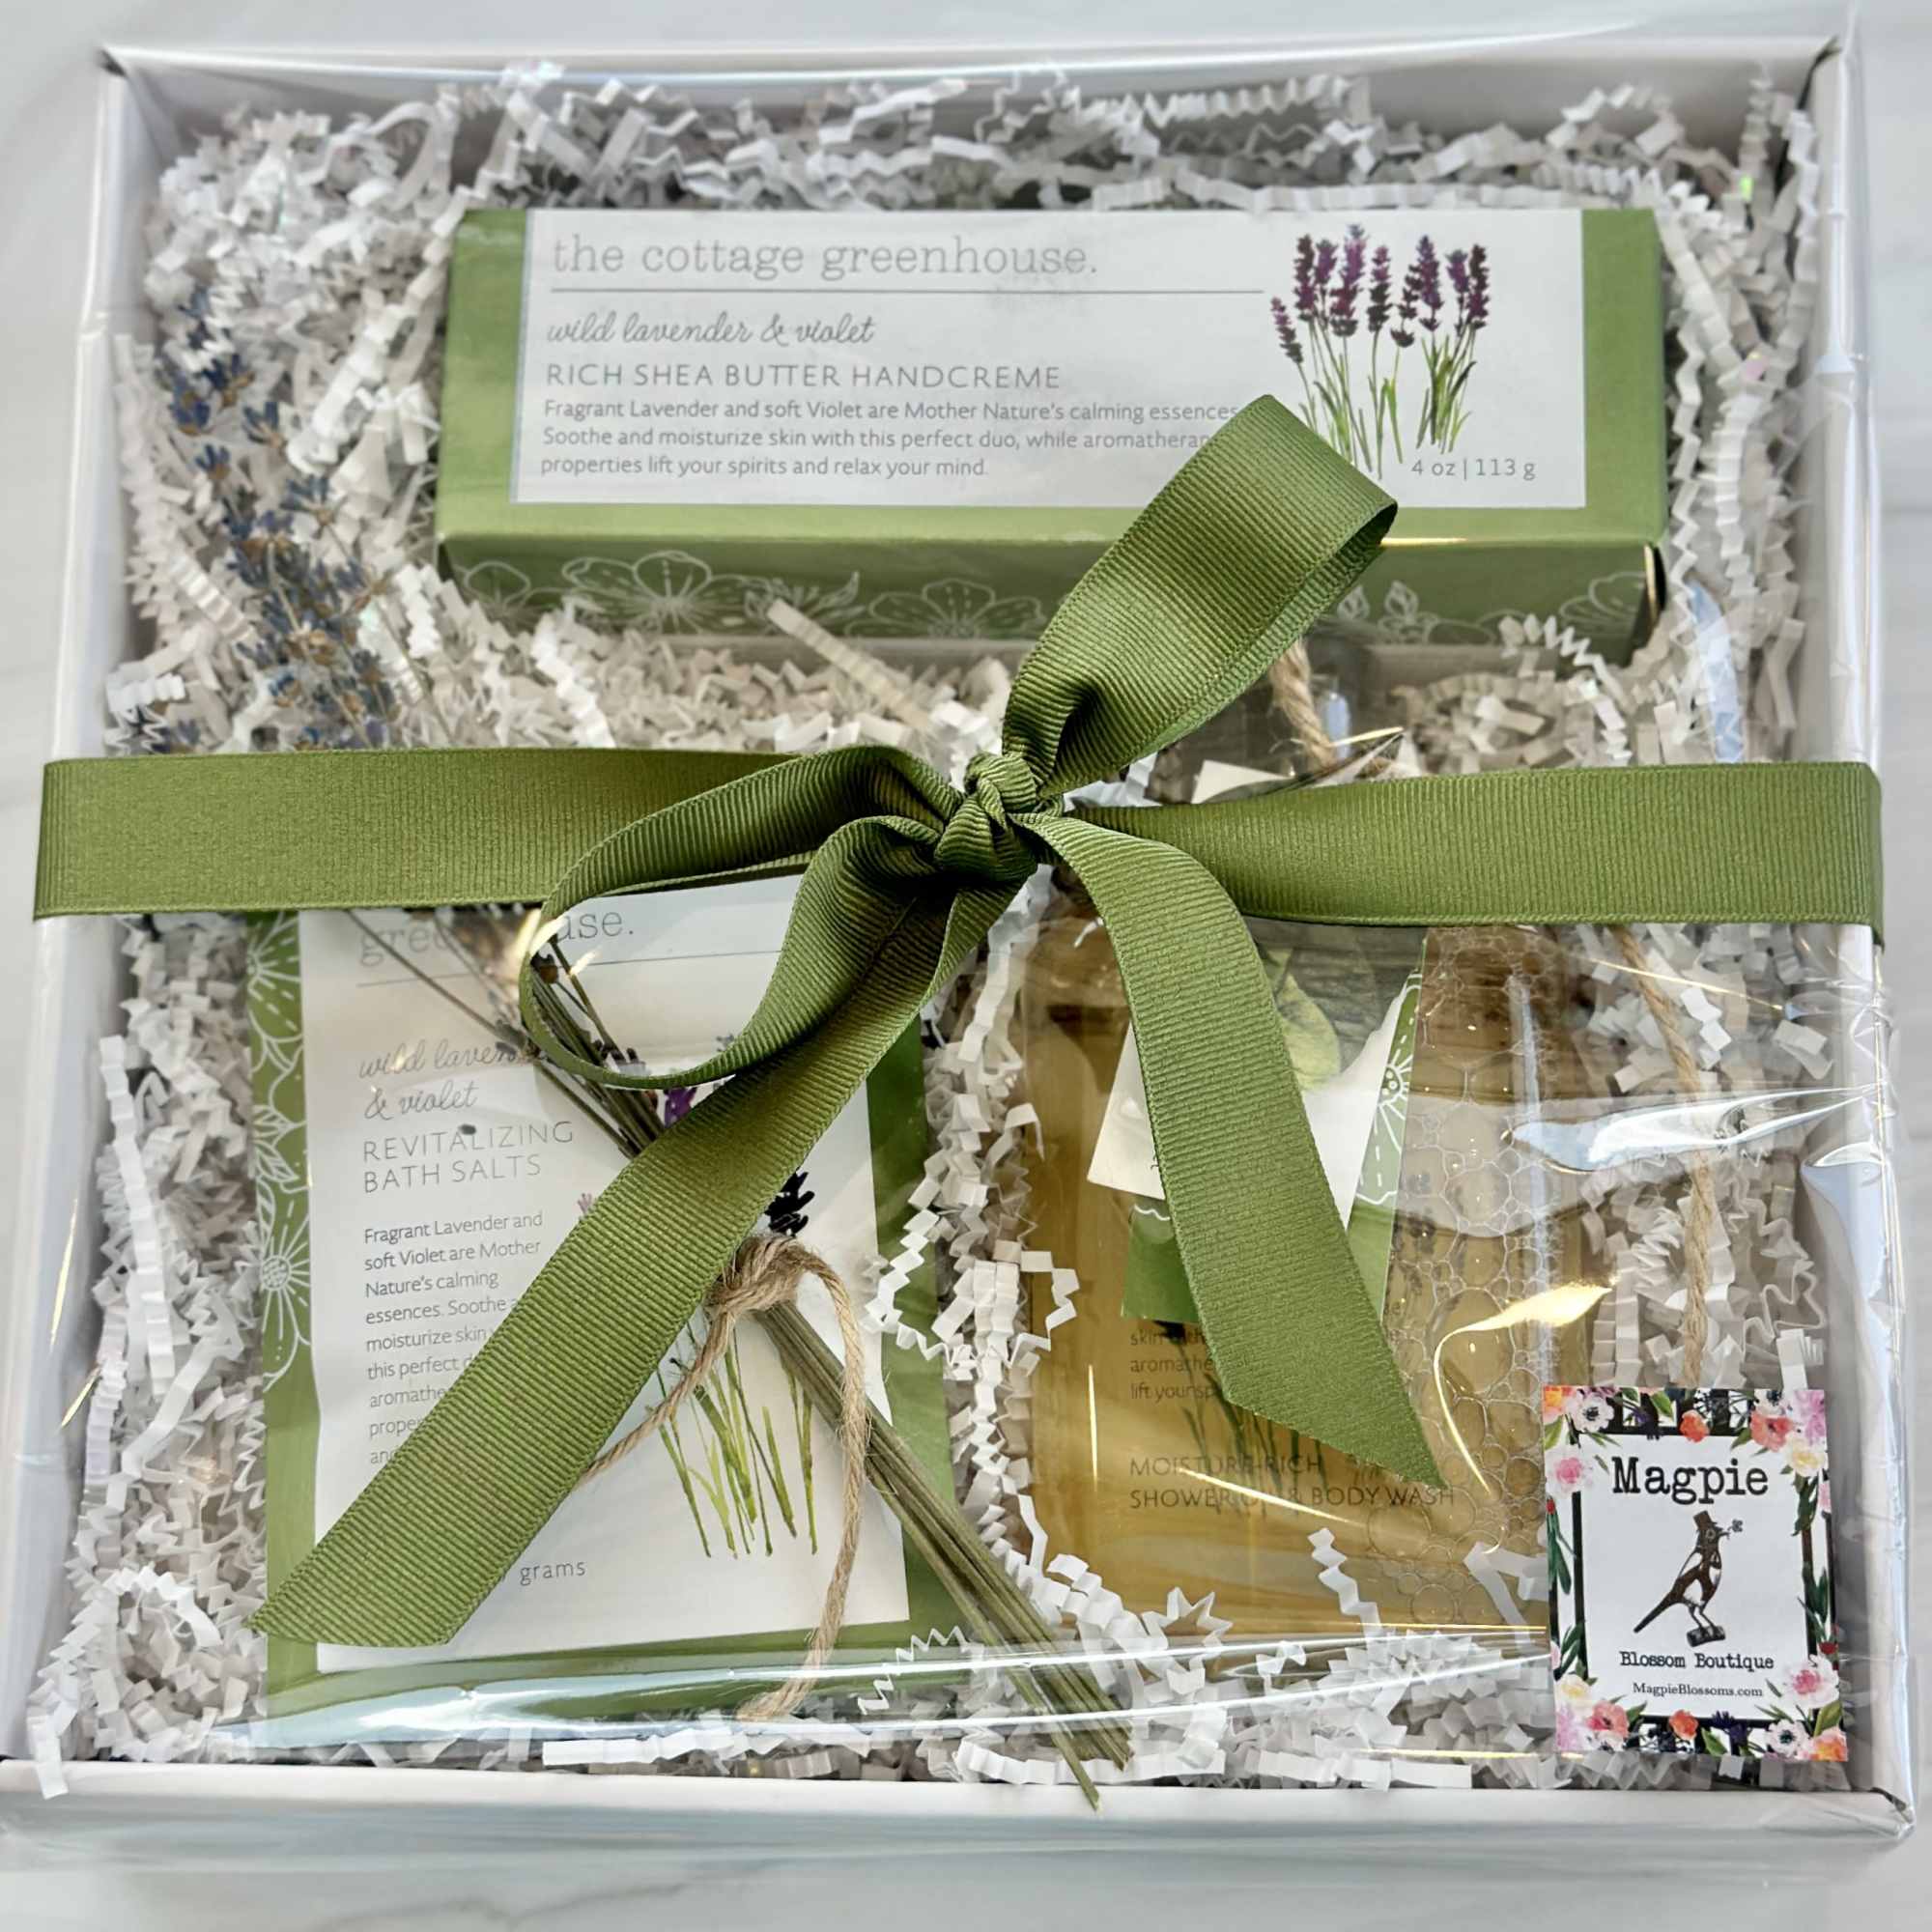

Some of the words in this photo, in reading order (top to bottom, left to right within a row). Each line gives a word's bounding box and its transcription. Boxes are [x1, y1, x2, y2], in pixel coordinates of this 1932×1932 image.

[554, 233, 624, 272] the
[642, 240, 804, 281] cottage
[820, 235, 1097, 282] greenhouse.
[547, 310, 616, 343] wild
[623, 310, 753, 343] lavender
[760, 312, 790, 347] &
[795, 312, 875, 344] violet
[547, 363, 623, 387] RICH
[634, 363, 713, 387] SHEA
[725, 364, 840, 387] BUTTER
[853, 365, 1060, 388] HANDCREME
[545, 399, 623, 421] Fragrant
[630, 399, 719, 418] Lavender
[724, 400, 759, 418] and
[764, 399, 801, 418] soft
[807, 401, 865, 419] Violet
[867, 405, 899, 419] are
[904, 401, 977, 420] Mother
[983, 402, 1064, 421] Nature's
[1069, 402, 1145, 424] calming
[543, 425, 612, 446] Soothe
[617, 427, 653, 445] and
[659, 427, 763, 447] moisturize
[769, 428, 807, 447] skin
[810, 429, 855, 447] with
[860, 428, 895, 447] this
[901, 428, 975, 451] perfect
[979, 430, 1021, 451] duo,
[1026, 430, 1077, 448] while
[541, 457, 642, 477] properties
[648, 456, 673, 473] lift
[678, 460, 722, 479] your
[728, 456, 788, 478] spirits
[793, 456, 828, 474] and
[834, 457, 881, 474] relax
[886, 462, 931, 480] your
[935, 458, 988, 475] mind.
[1411, 459, 1423, 476] 4
[1523, 462, 1538, 481] g
[358, 1039, 427, 1078] wild
[434, 1038, 519, 1069] laven
[364, 1087, 394, 1121] &
[398, 1080, 479, 1114] violet
[363, 1121, 574, 1162] REVITALIZING
[364, 1163, 440, 1193] BATH
[451, 1153, 541, 1182] SALTS
[364, 1222, 432, 1245] Fragrant
[434, 1214, 509, 1237] Lavender
[513, 1211, 543, 1230] and
[364, 1253, 396, 1271] soft
[399, 1246, 446, 1266] Violet
[449, 1246, 475, 1262] are
[479, 1238, 541, 1260] Mother
[365, 1274, 433, 1297] Nature's
[436, 1270, 498, 1290] calming
[448, 1295, 506, 1316] Soothe
[367, 1329, 453, 1352] moisturize
[456, 1324, 487, 1343] skin
[368, 1361, 396, 1380] this
[400, 1356, 459, 1379] perfect
[1610, 1456, 1769, 1505] Magpie
[1129, 1488, 1232, 1509] SHOWER
[1311, 1486, 1380, 1507] BODY
[1385, 1485, 1454, 1507] WASH
[520, 1561, 587, 1586] grams
[1619, 1650, 1686, 1669] Blossom
[1694, 1652, 1775, 1673] Boutique
[1633, 1682, 1764, 1699] MagpieBlossoms.com
